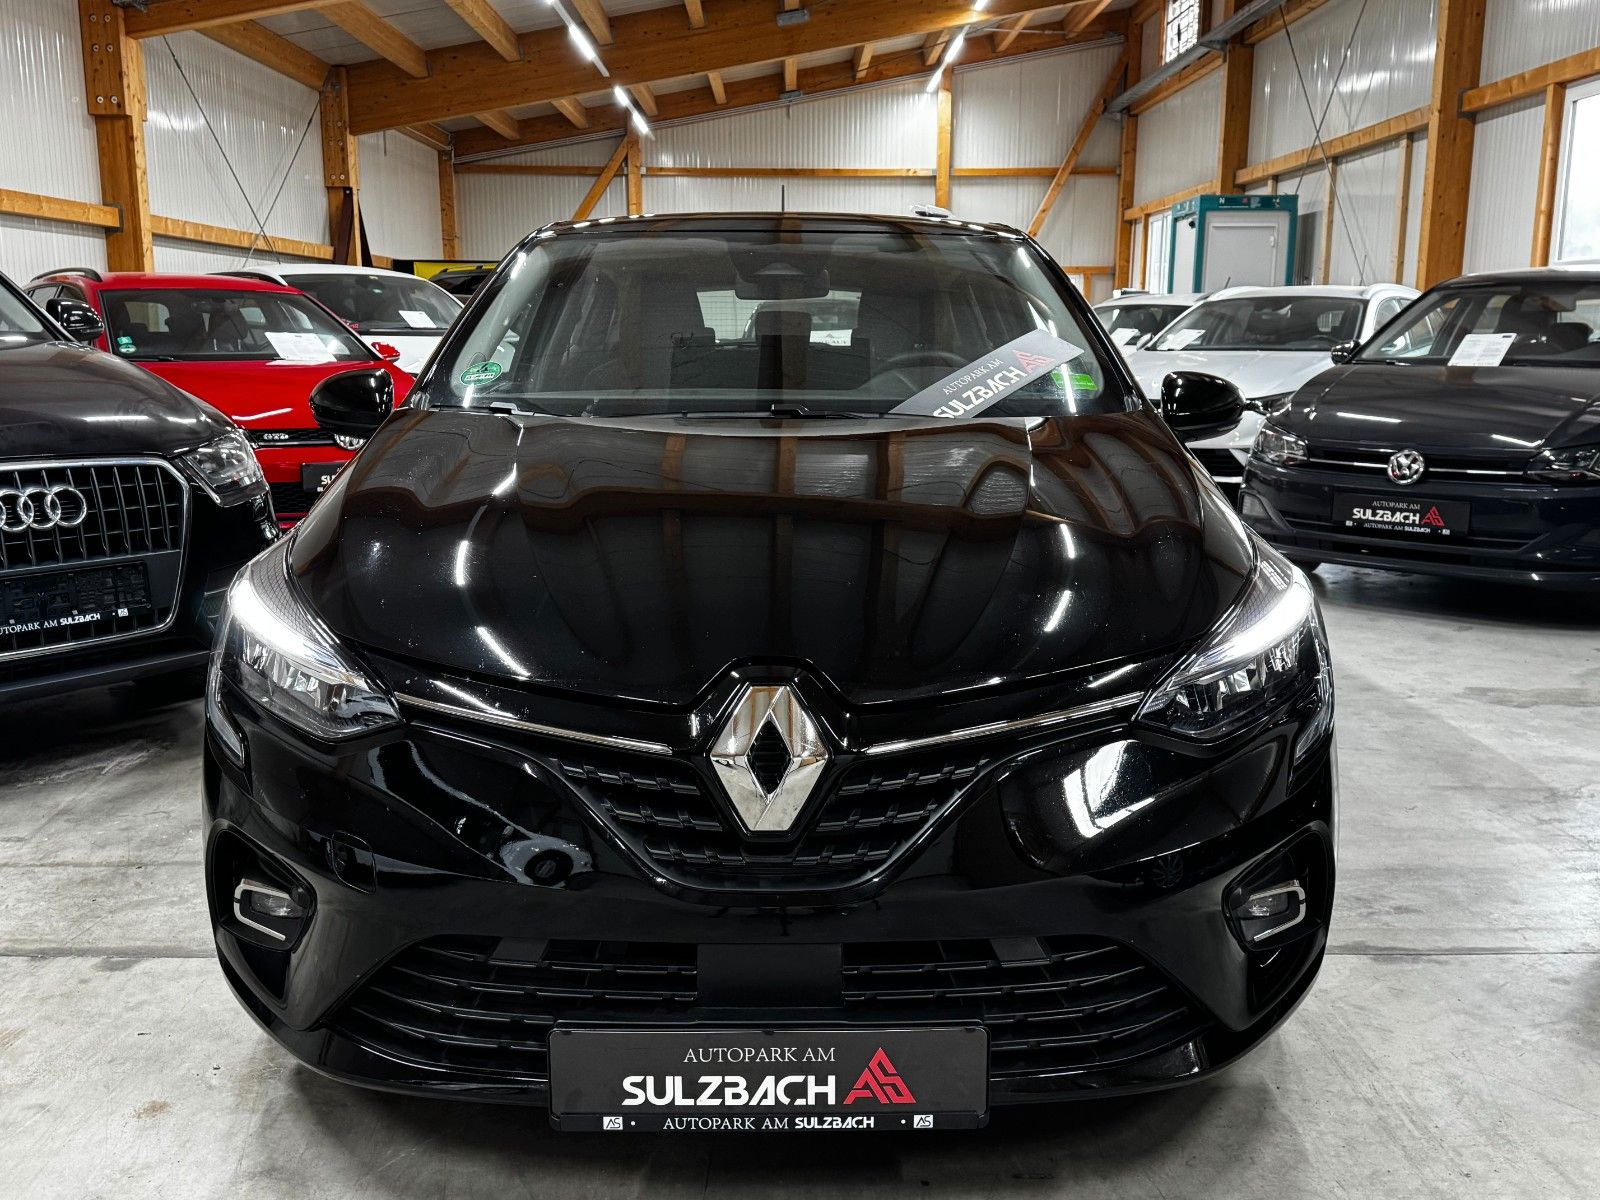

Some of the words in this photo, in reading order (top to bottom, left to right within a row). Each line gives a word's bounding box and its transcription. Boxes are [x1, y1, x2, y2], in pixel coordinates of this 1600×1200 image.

[942, 365, 988, 395] AUTOPARK
[987, 358, 1004, 369] AM
[933, 366, 1028, 418] SULZBACH
[1372, 500, 1408, 509] AUTOPARK
[1352, 507, 1420, 525] SULZBACH
[1363, 522, 1393, 530] AUTOPARK
[1404, 525, 1431, 533] SULZBACH
[0, 621, 41, 635] UTOPARK
[43, 619, 58, 629] AM
[59, 612, 101, 626] SULZBACH
[683, 1047, 798, 1063] AUTOPARK
[802, 1047, 836, 1062] AM
[621, 1075, 836, 1106] SULZBACH
[605, 1117, 621, 1129] AS
[663, 1117, 755, 1130] AUTOPARK
[763, 1117, 789, 1130] AM
[794, 1116, 875, 1129] SULZBACH
[916, 1115, 932, 1127] AS
